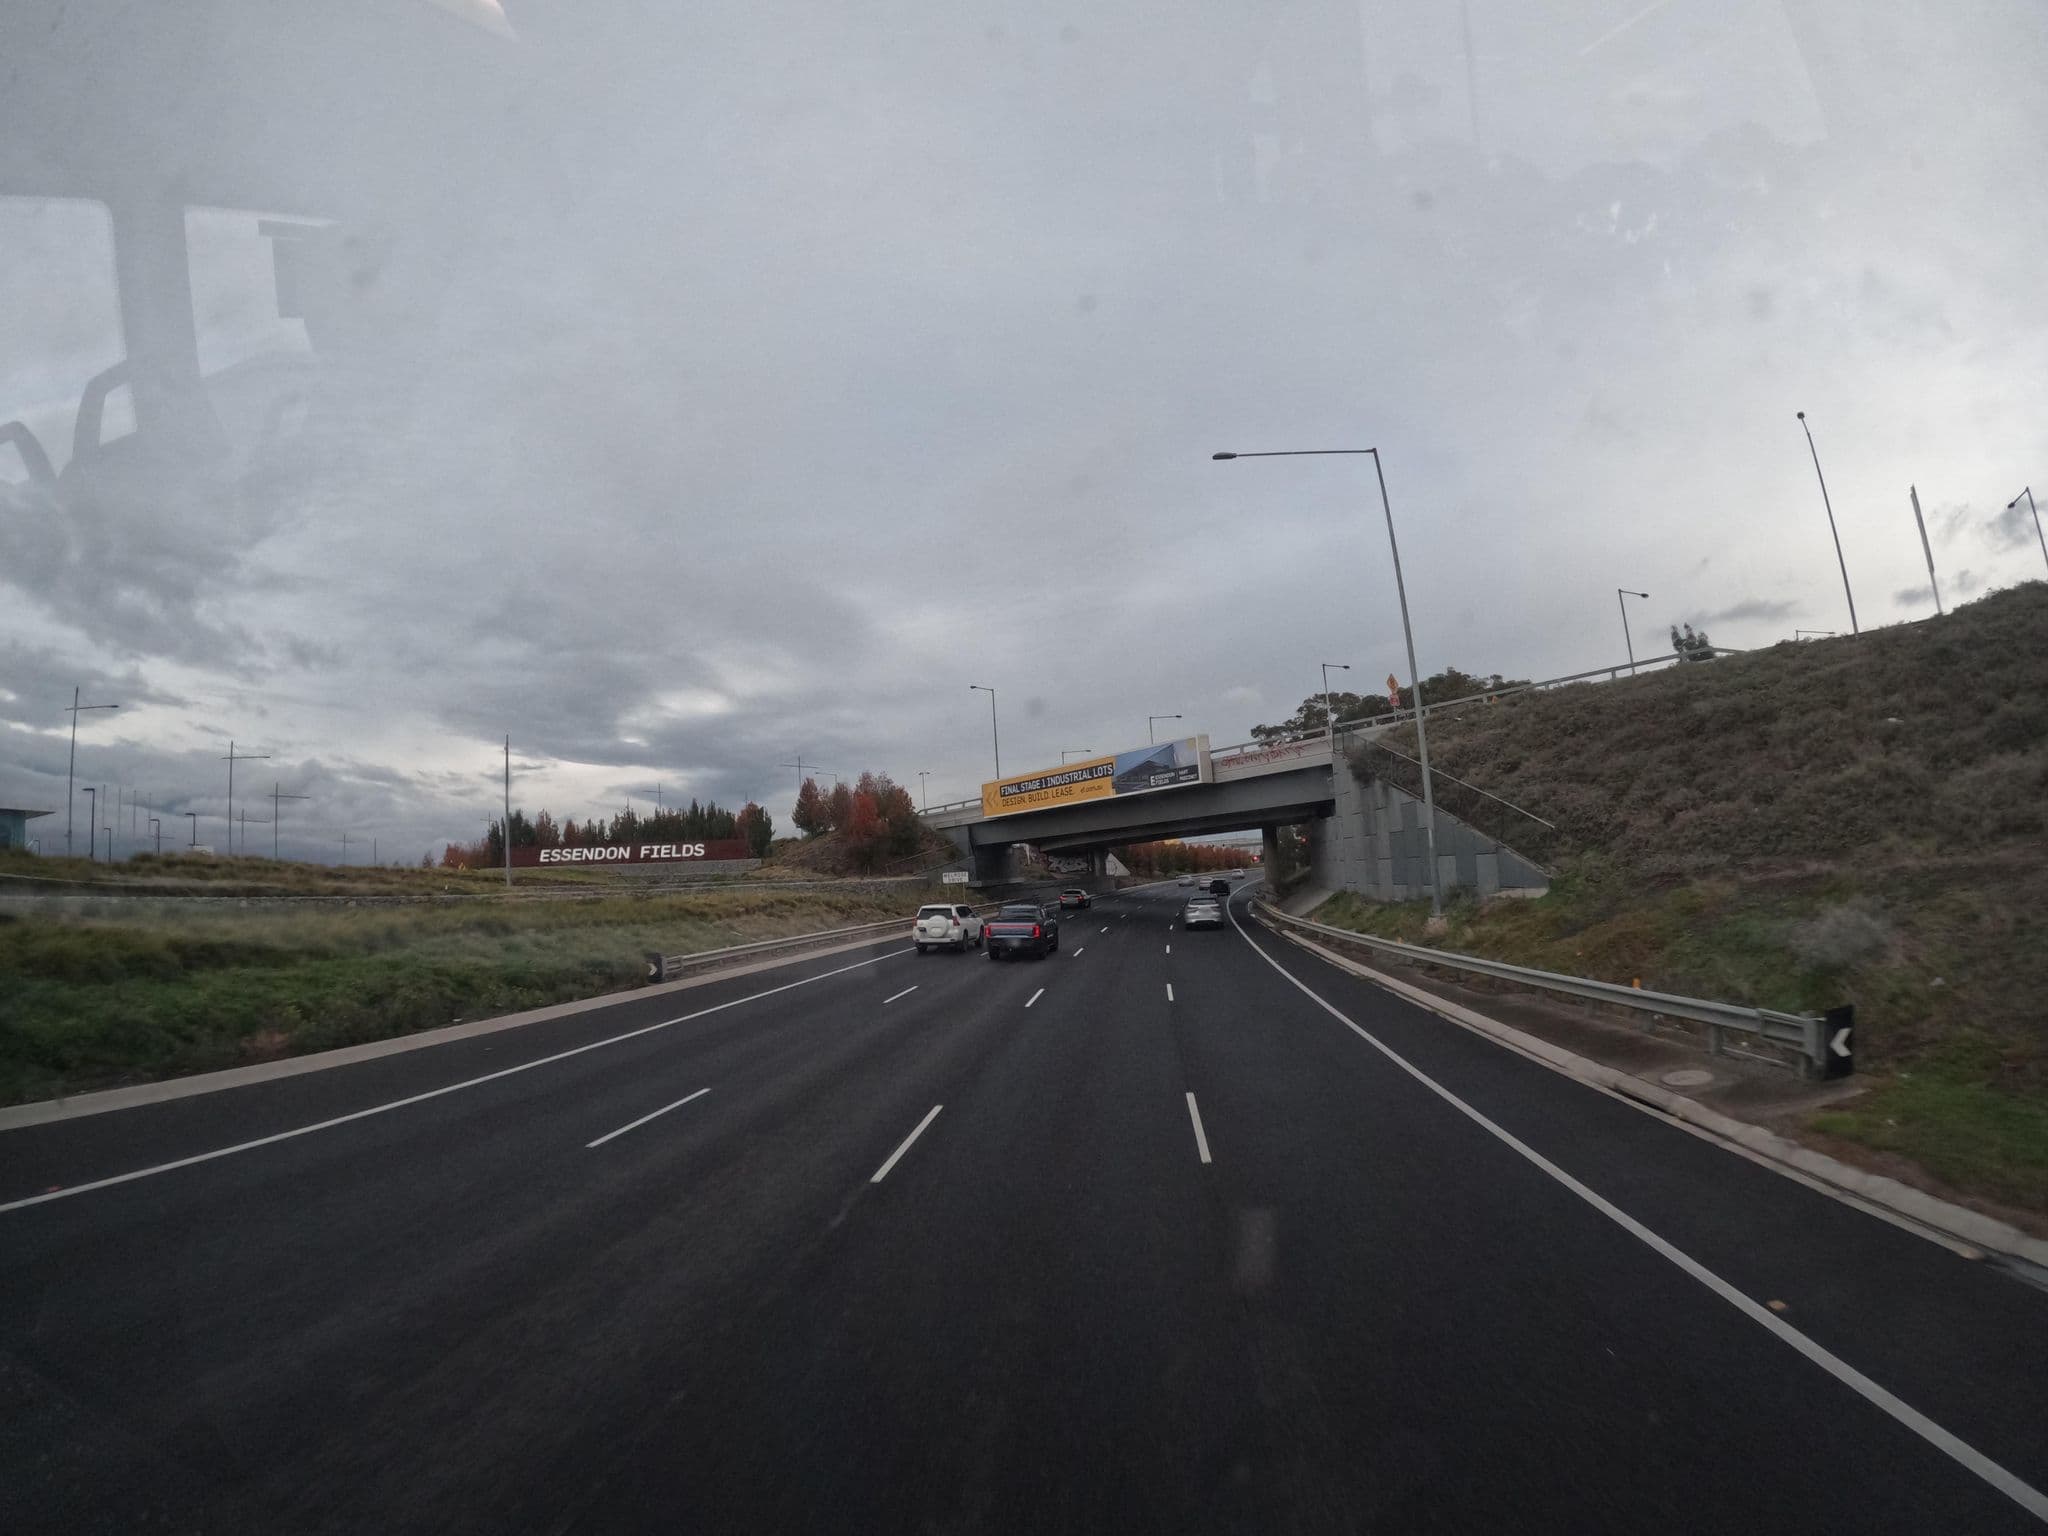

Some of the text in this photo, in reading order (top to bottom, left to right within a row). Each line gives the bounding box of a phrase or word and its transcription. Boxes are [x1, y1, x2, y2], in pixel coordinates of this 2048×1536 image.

[1001, 784, 1021, 795] FINAL
[1020, 780, 1041, 792] STAGE
[1047, 770, 1092, 786] INDUSTRIAL
[1093, 764, 1113, 777] LOTS
[540, 843, 705, 863] ESSENDON FIELDS
